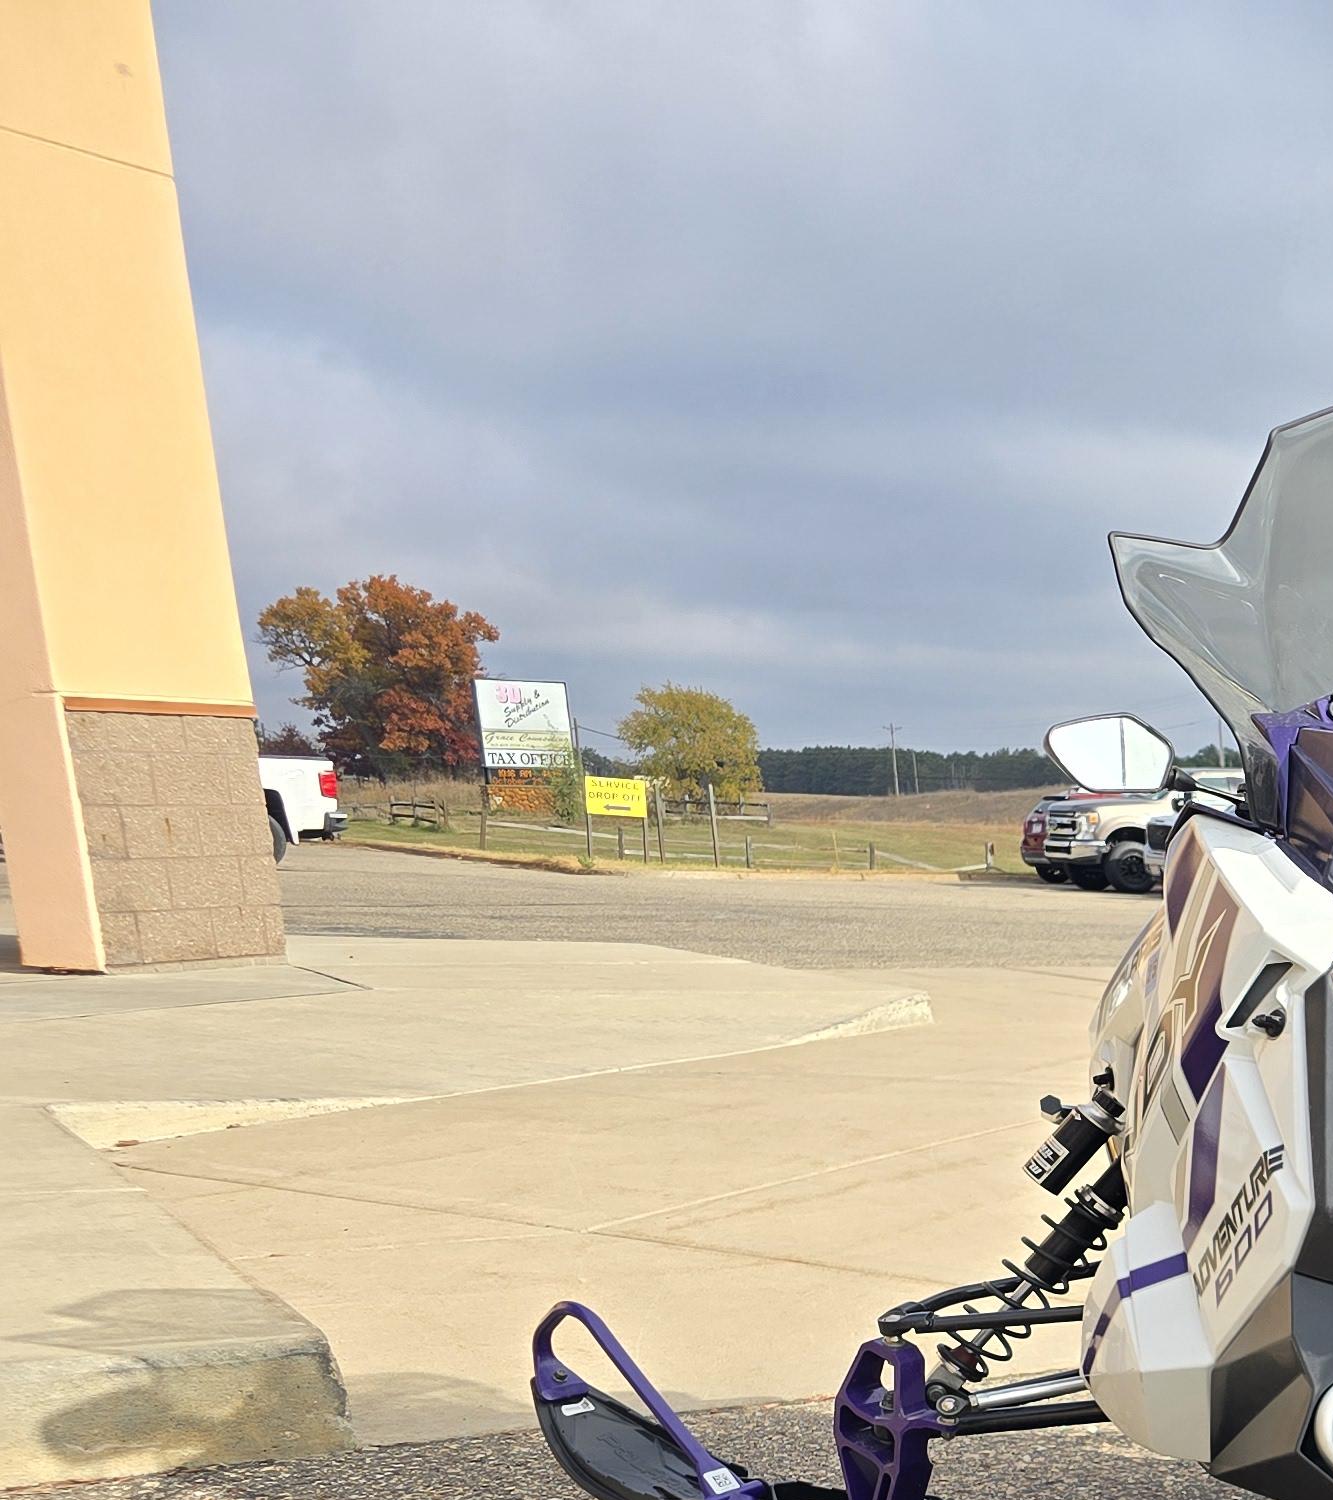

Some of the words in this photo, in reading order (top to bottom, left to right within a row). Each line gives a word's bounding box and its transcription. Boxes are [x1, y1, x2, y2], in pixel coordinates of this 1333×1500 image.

[487, 753, 517, 765] TAX
[520, 753, 569, 766] OFFICE
[591, 780, 639, 790] SERVICE
[588, 791, 619, 800] DROP
[1214, 1190, 1273, 1309] 600
